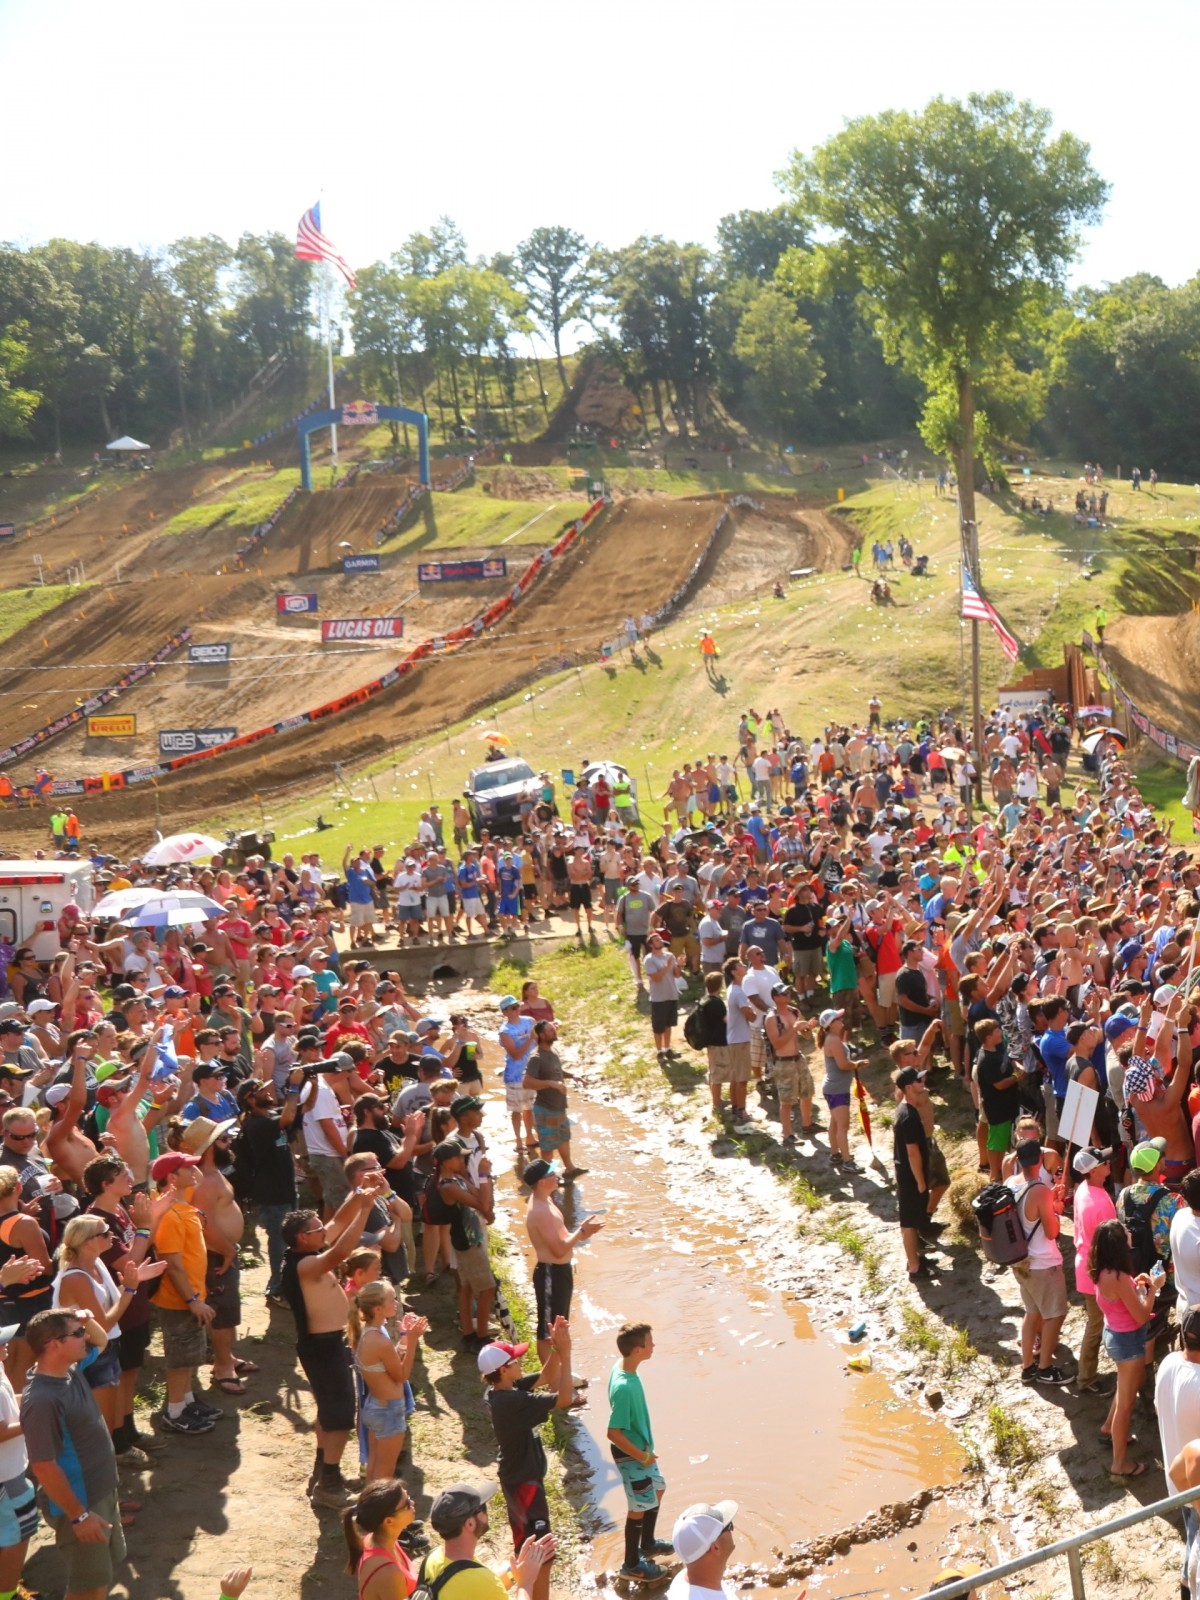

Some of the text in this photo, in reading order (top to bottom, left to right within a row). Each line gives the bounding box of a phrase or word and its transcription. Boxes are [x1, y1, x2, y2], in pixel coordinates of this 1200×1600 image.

[345, 559, 378, 568] GARMIN
[327, 619, 395, 638] LUCAS OIL
[190, 645, 227, 657] GEICO
[90, 719, 132, 732] PIRELLI
[160, 732, 196, 751] WPS
